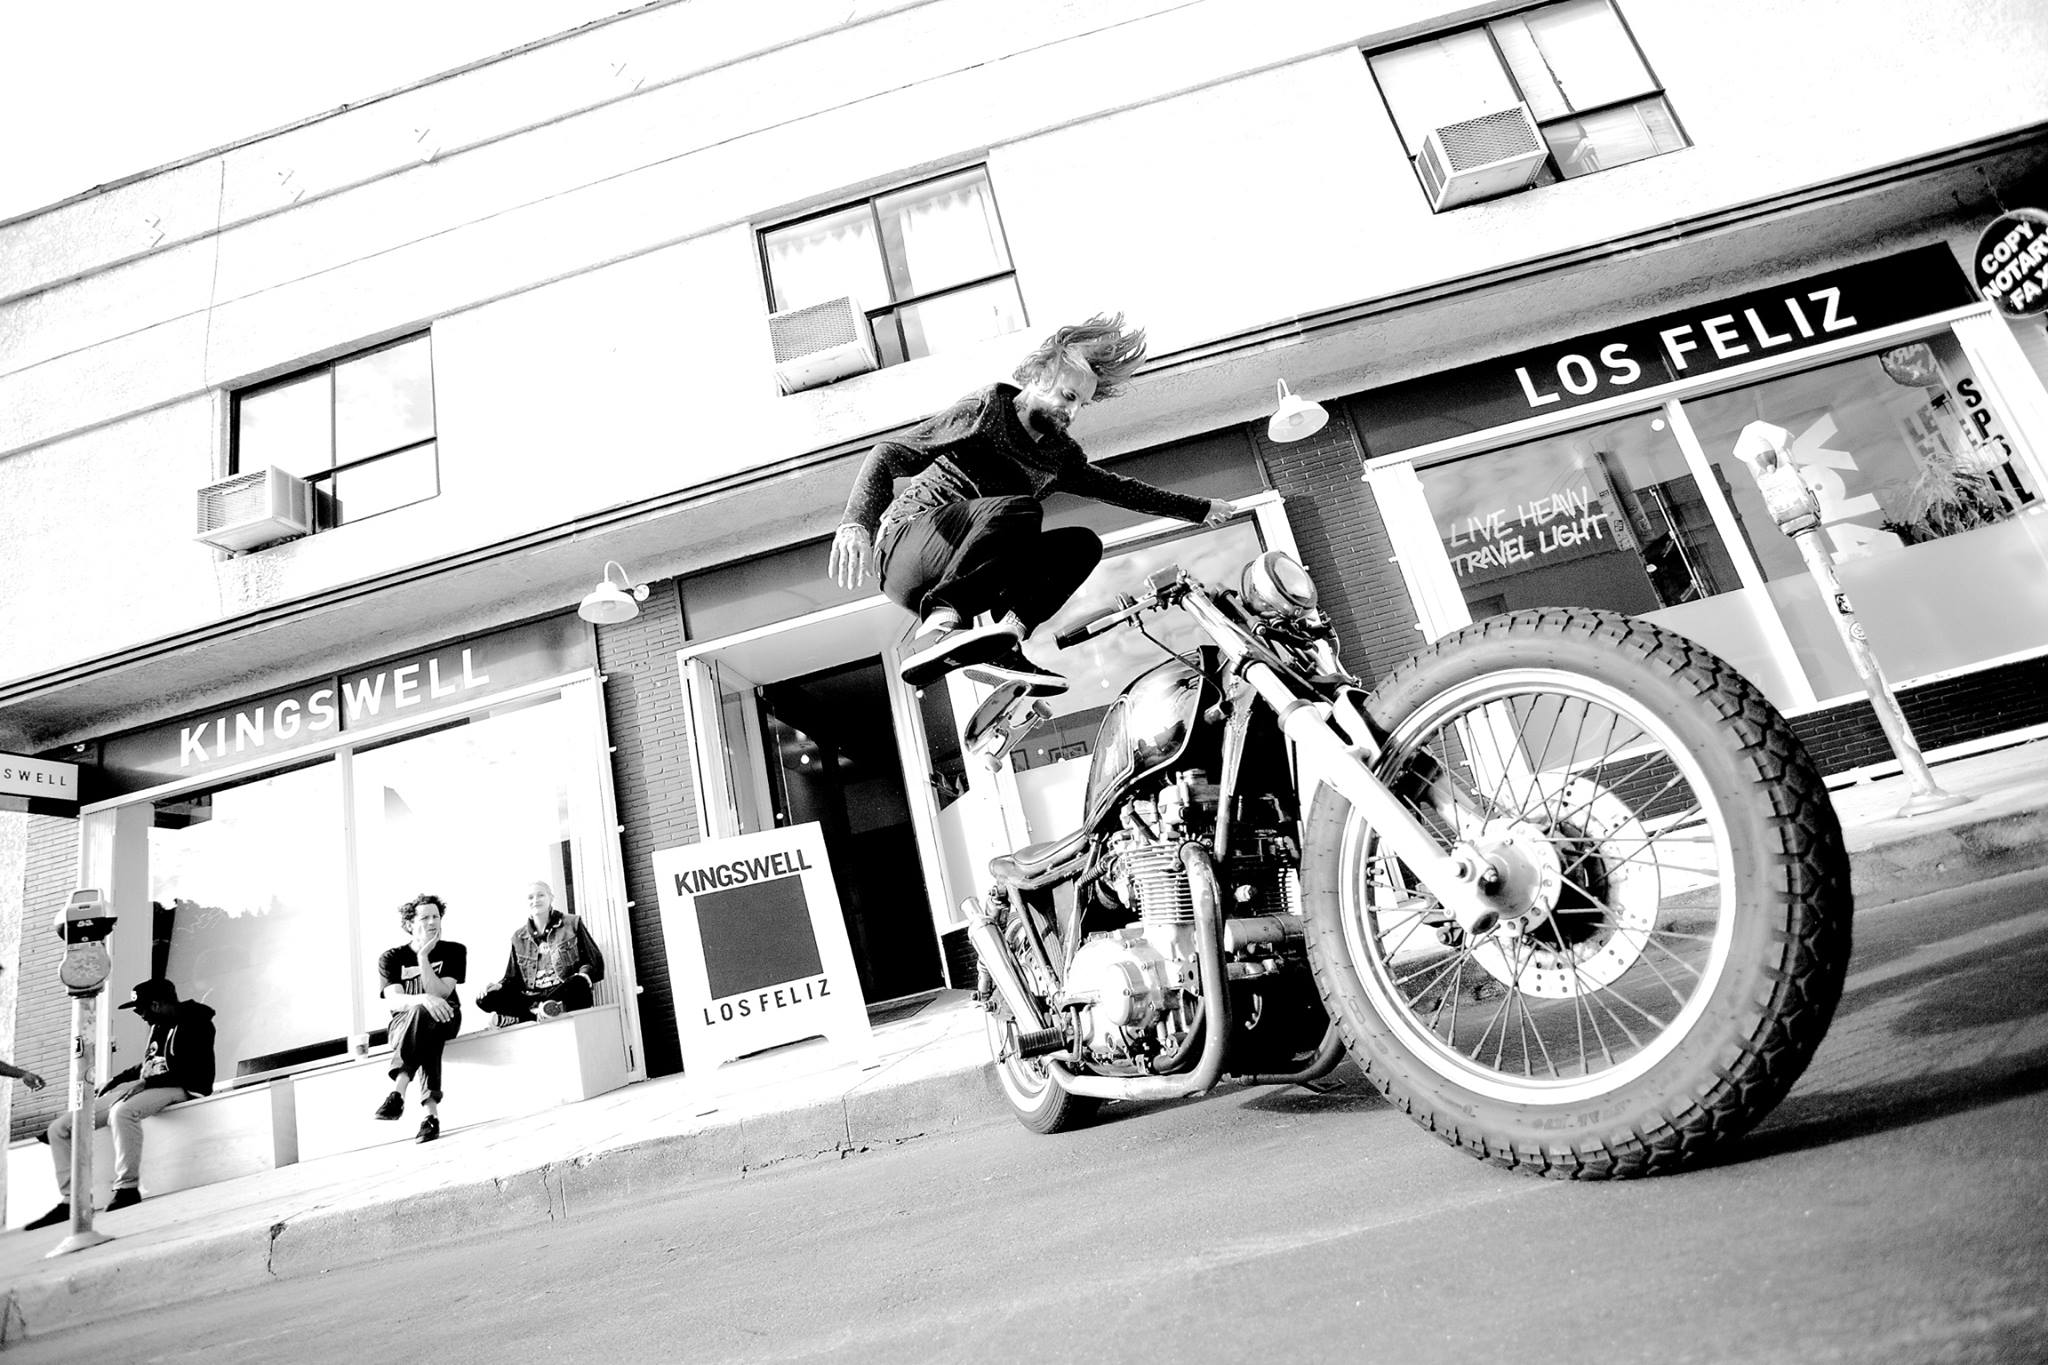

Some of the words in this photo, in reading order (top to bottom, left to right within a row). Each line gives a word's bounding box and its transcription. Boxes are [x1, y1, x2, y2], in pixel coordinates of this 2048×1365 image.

[1981, 221, 2034, 274] COPY
[1515, 343, 1641, 408] LOS
[1659, 286, 1857, 371] FELIZ
[1450, 509, 1513, 548] LIVE
[1518, 486, 1588, 529] HEAVY
[1450, 535, 1534, 577] TRAVEL
[1539, 514, 1608, 554] LIGHT
[180, 648, 490, 769] KINGSWELL
[3, 768, 67, 786] SWELL
[674, 849, 813, 897] KINGSWELL
[703, 999, 751, 1026] LOS
[759, 978, 831, 1012] FELIZ
